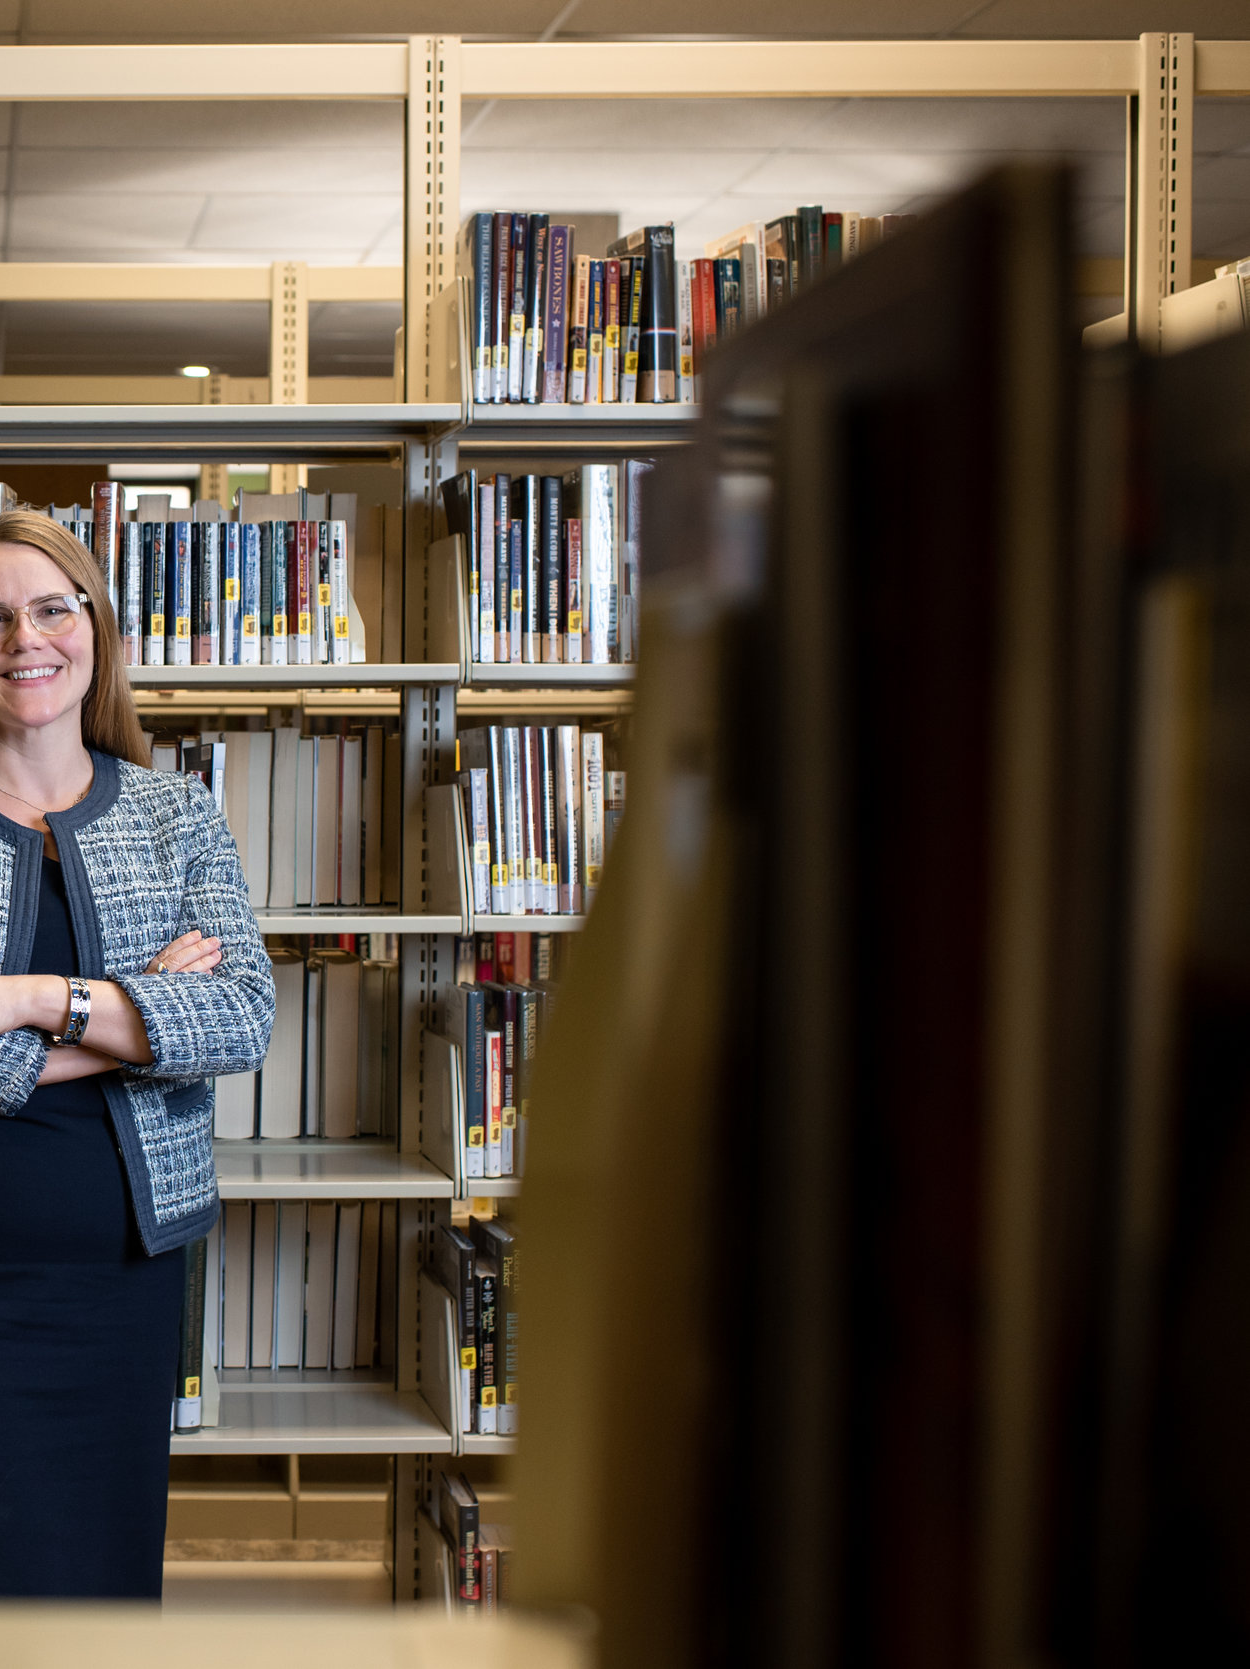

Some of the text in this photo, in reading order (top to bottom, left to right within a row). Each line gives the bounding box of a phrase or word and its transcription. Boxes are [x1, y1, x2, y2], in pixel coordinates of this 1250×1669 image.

[481, 223, 490, 242] THE
[552, 236, 563, 314] SAWBONES
[550, 497, 558, 526] MONTY
[549, 529, 558, 562] McCORD
[549, 579, 558, 611] WHEN
[587, 760, 600, 792] 1001
[527, 1002, 537, 1032] DOUBLE
[505, 1073, 513, 1098] STEPHEN
[503, 1256, 513, 1288] Parker
[506, 1312, 518, 1371] BLUE-EYED
[483, 1343, 494, 1385] BLUE-EYED
